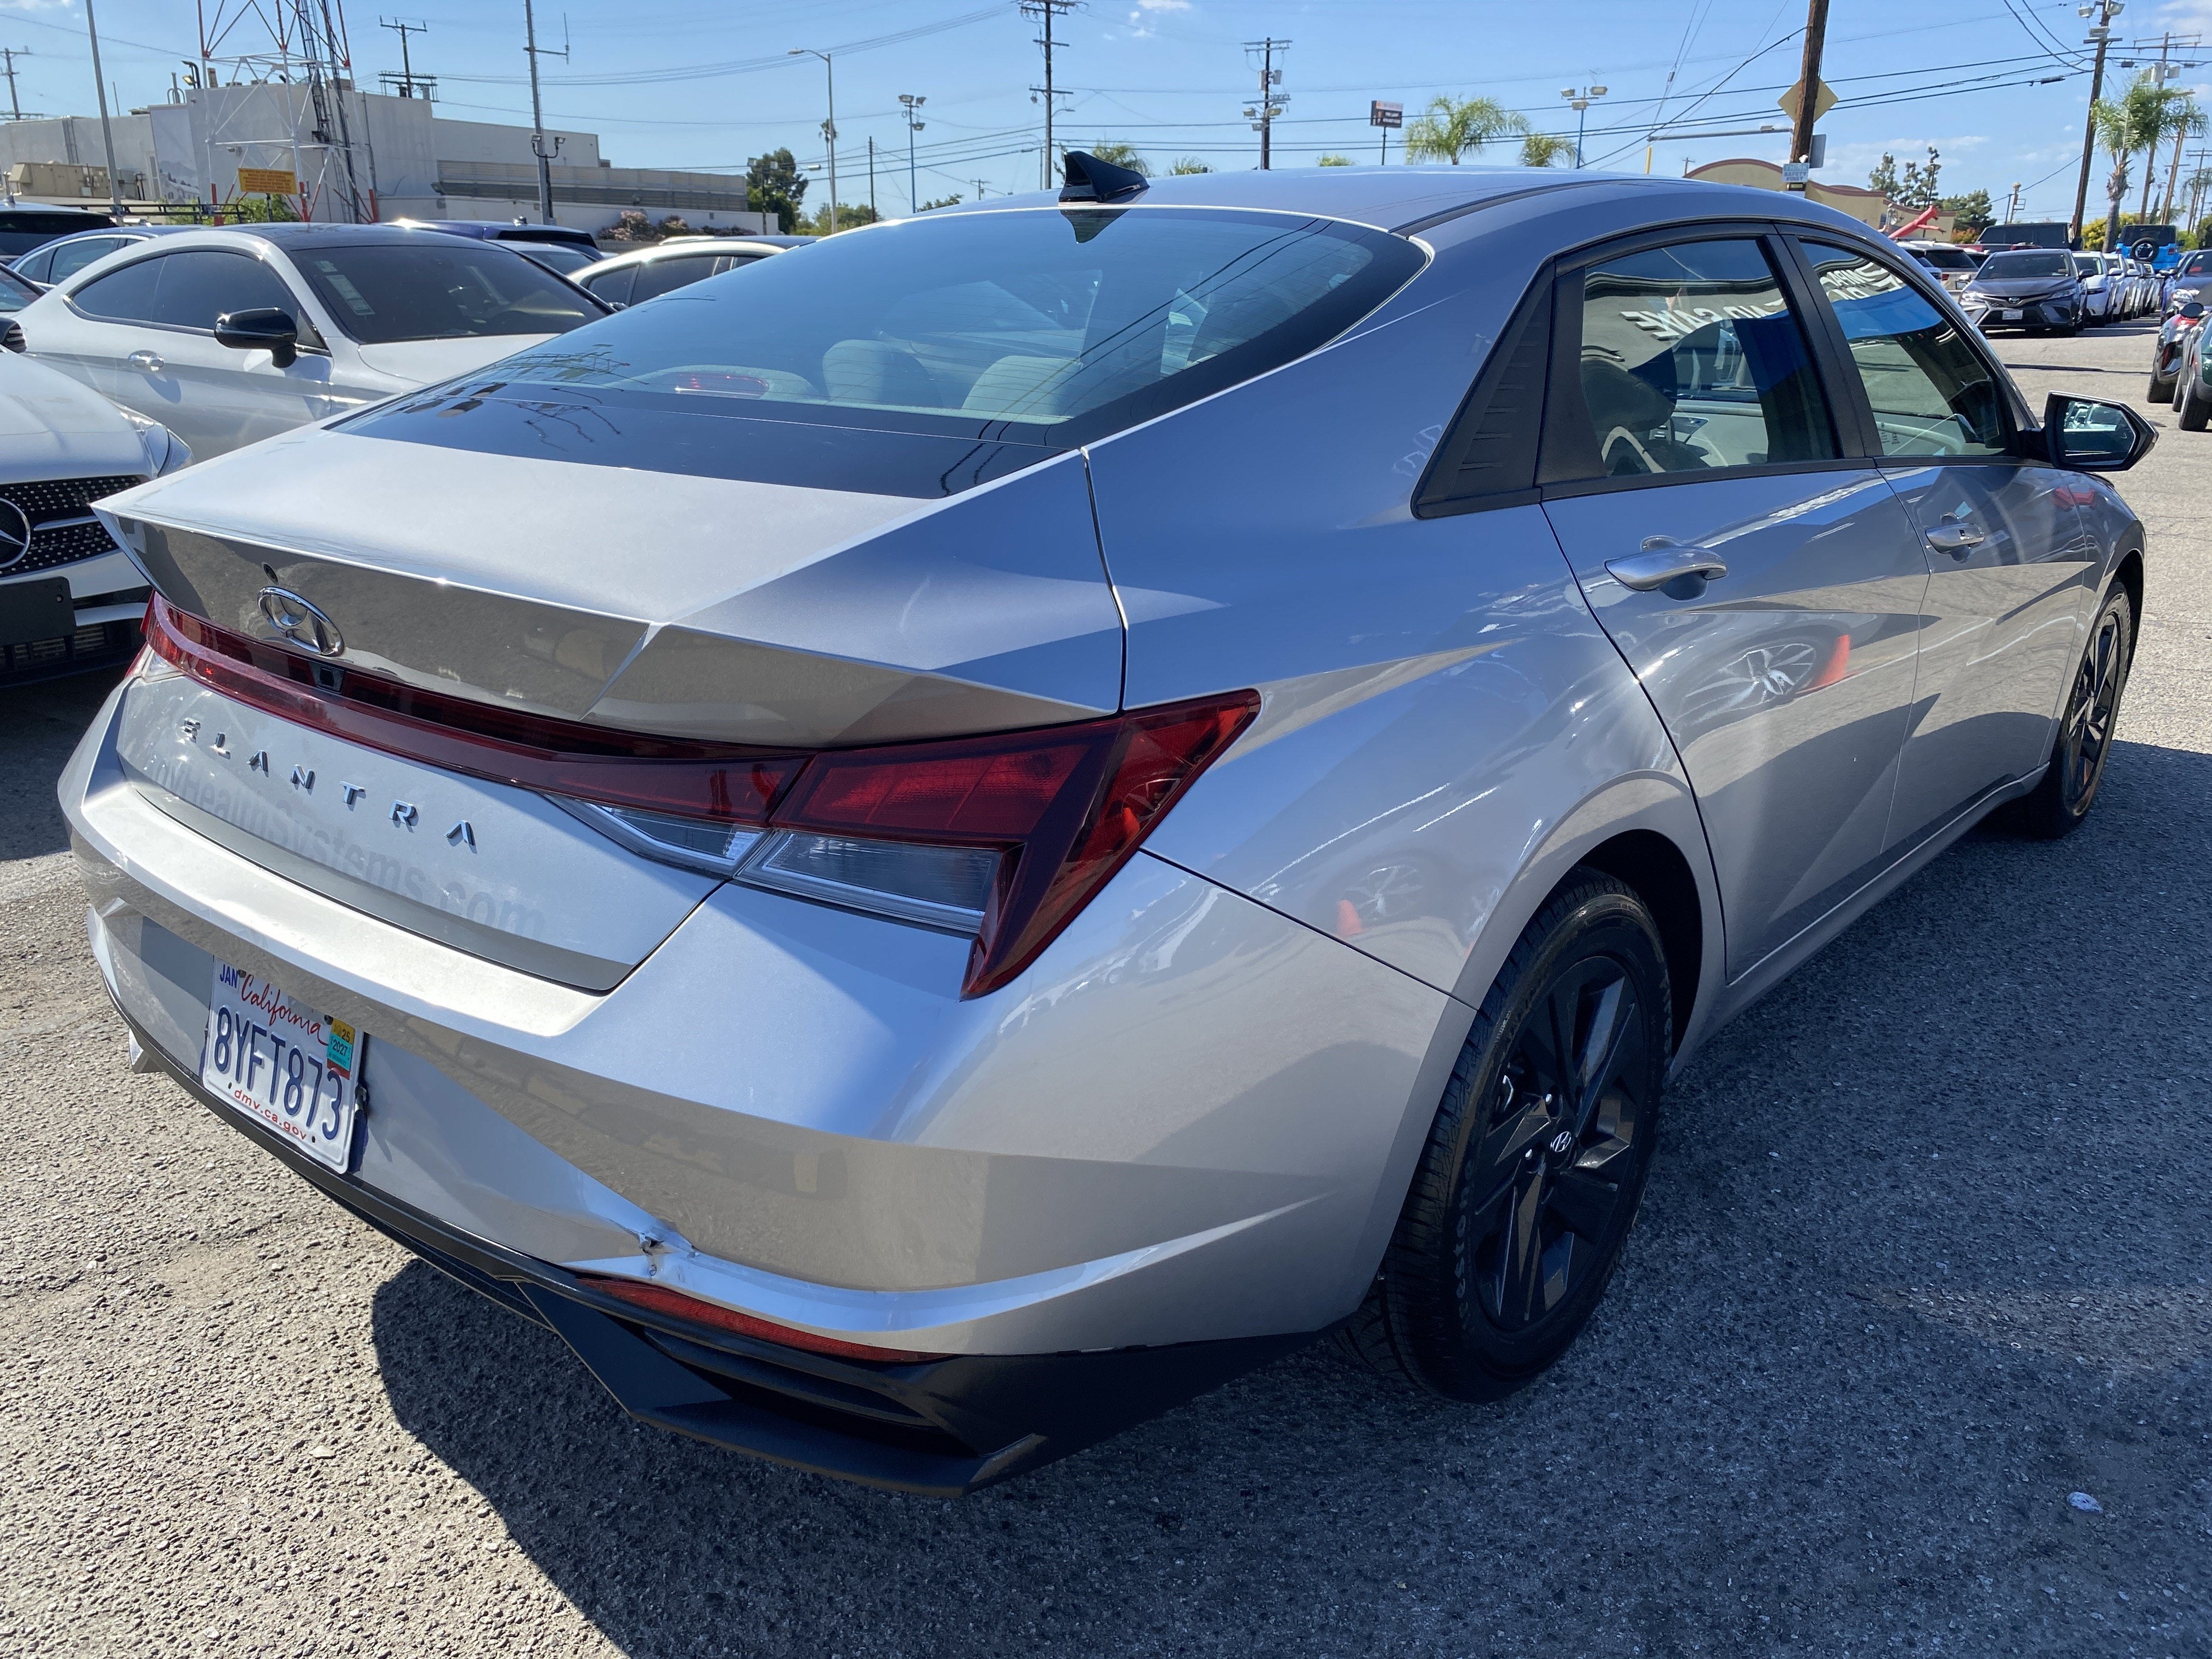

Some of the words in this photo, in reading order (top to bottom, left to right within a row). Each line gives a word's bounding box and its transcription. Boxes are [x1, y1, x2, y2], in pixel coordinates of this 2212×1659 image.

[182, 717, 476, 847] ELANTRA
[219, 964, 239, 989] JAN
[240, 973, 328, 1046] California
[214, 1006, 343, 1141] 8YFT873
[332, 1038, 348, 1057] 2027
[234, 1088, 307, 1140] dmv.ca.gov
